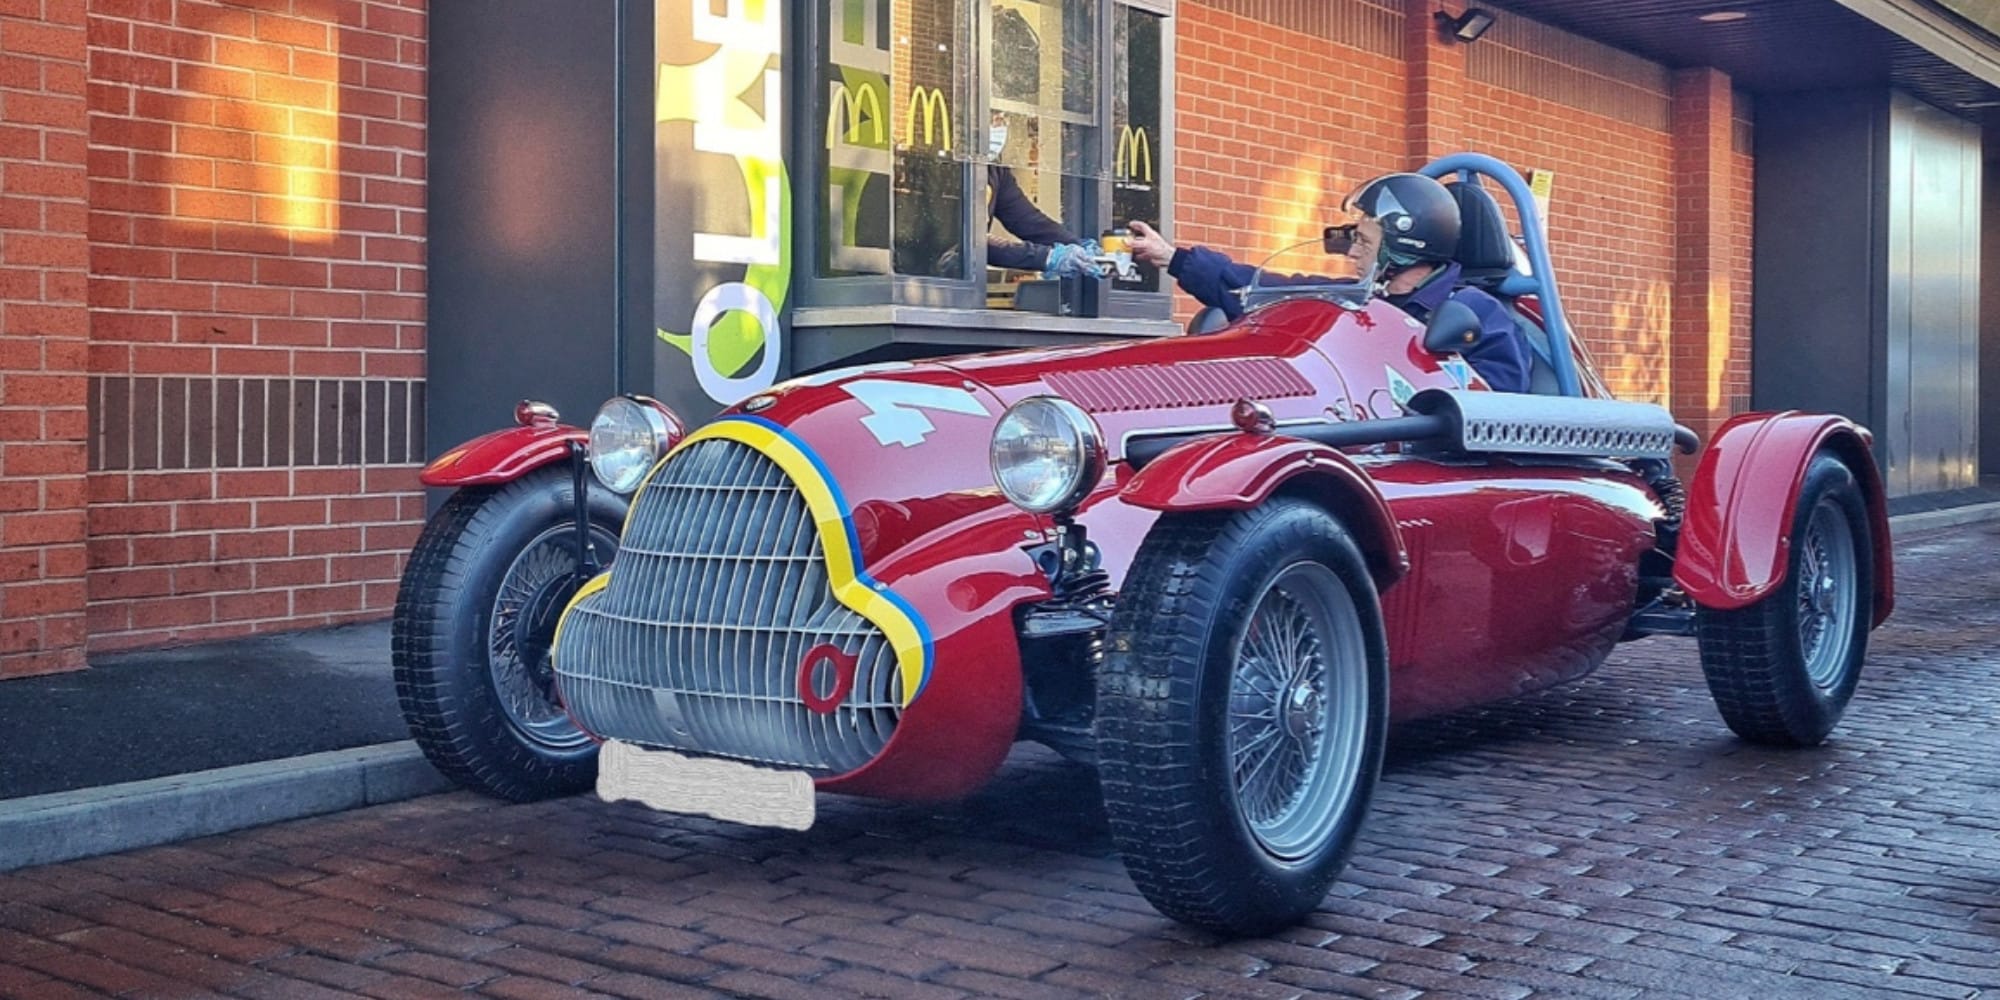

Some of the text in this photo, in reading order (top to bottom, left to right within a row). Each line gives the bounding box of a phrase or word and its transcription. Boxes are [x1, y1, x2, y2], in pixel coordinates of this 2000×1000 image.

[826, 83, 884, 149] M
[906, 85, 951, 150] M
[1116, 124, 1152, 182] M
[839, 379, 992, 448] 4
